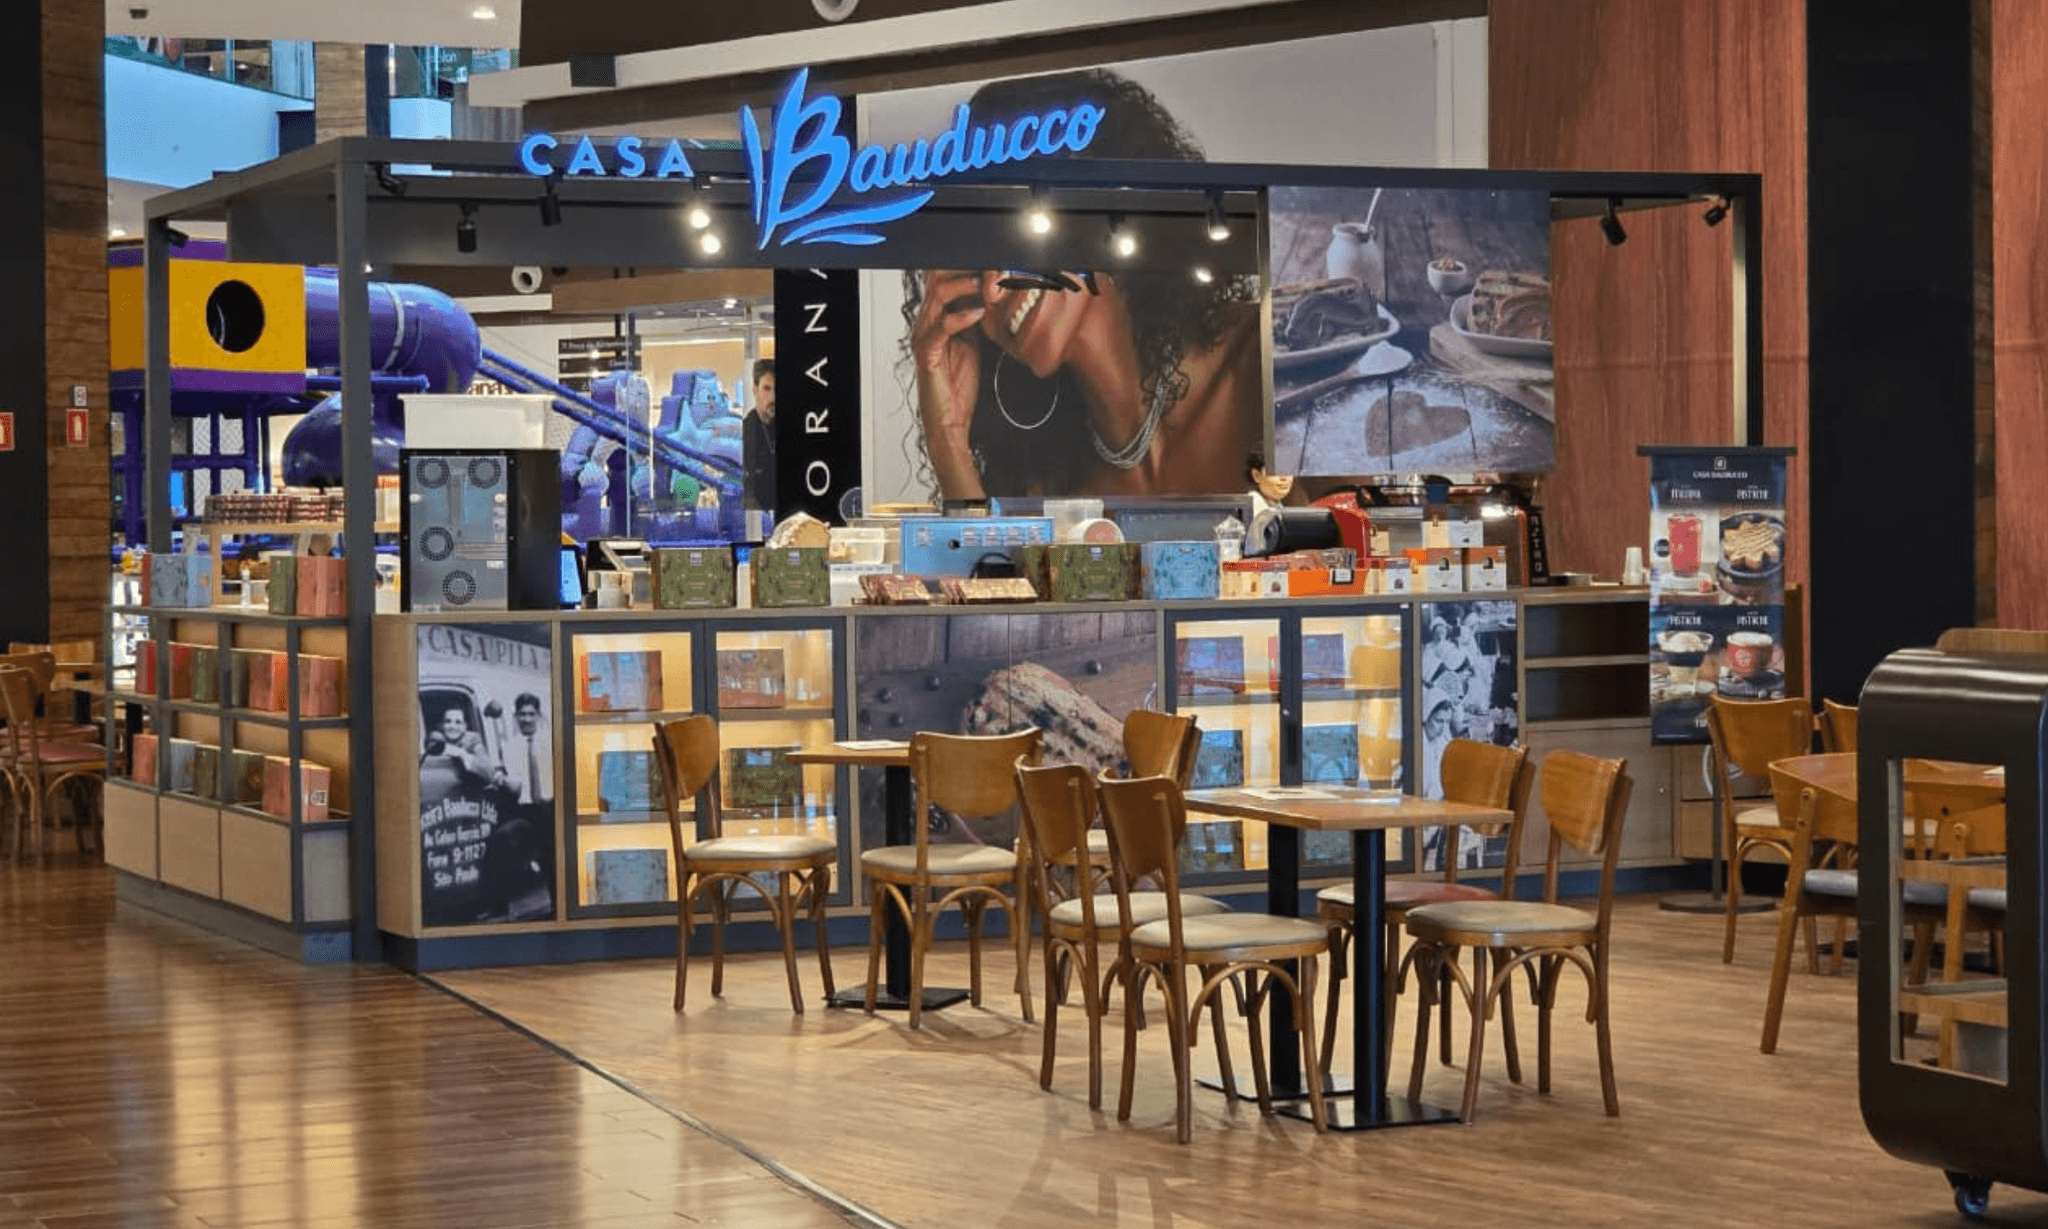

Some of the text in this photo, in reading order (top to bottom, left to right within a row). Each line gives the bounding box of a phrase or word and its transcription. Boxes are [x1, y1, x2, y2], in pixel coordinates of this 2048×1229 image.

[522, 68, 1105, 249] CASA Bauducco
[427, 624, 488, 662] CASA
